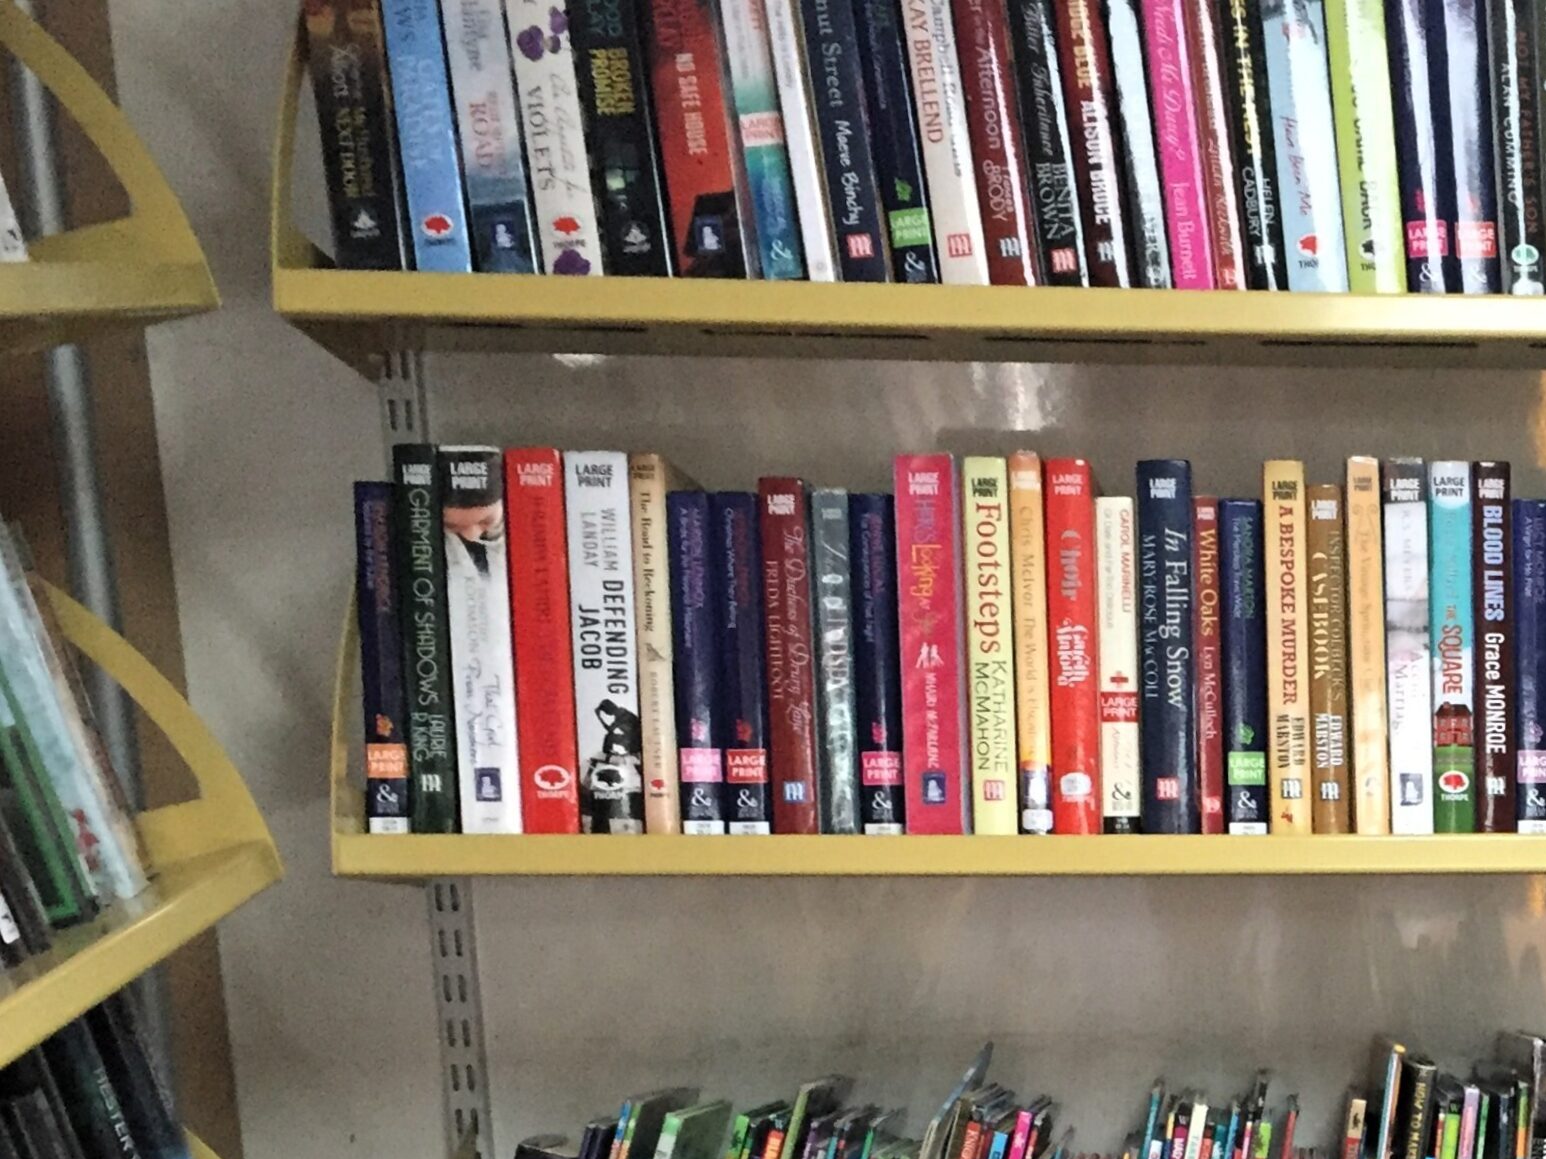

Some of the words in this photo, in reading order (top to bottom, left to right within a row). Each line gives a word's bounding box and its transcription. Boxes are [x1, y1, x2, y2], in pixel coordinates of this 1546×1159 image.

[822, 43, 849, 108] Street
[913, 39, 945, 144] BRELLEND
[970, 46, 1003, 150] Afternoon
[832, 120, 853, 167] Maeve
[838, 172, 864, 226] Binchy
[1034, 162, 1060, 240] BROWN
[1051, 162, 1075, 238] BENITA
[1172, 181, 1194, 217] Jean
[1175, 221, 1200, 281] Burnett
[407, 488, 434, 575] GARMENT
[581, 511, 599, 569] LANDAY
[601, 508, 620, 572] WILLIAM
[1199, 529, 1218, 577] White
[1483, 504, 1504, 566] BLOOD
[973, 502, 1003, 655] Footsteps
[1159, 557, 1189, 640] Falling
[1280, 521, 1296, 613] BESPOKE
[1484, 570, 1504, 622] LINES
[578, 604, 604, 671] JACOB
[602, 579, 629, 696] DEFENDING
[1200, 583, 1219, 638] Oaks
[414, 610, 437, 707] SHADOWS
[1165, 645, 1188, 709] Snow
[1280, 619, 1298, 706] MURDER
[1441, 625, 1464, 695] SQUARE
[1484, 632, 1505, 681] Grace
[975, 662, 992, 771] MCMAHON
[992, 661, 1010, 774] KATHARINE
[1484, 685, 1507, 755] MONROE
